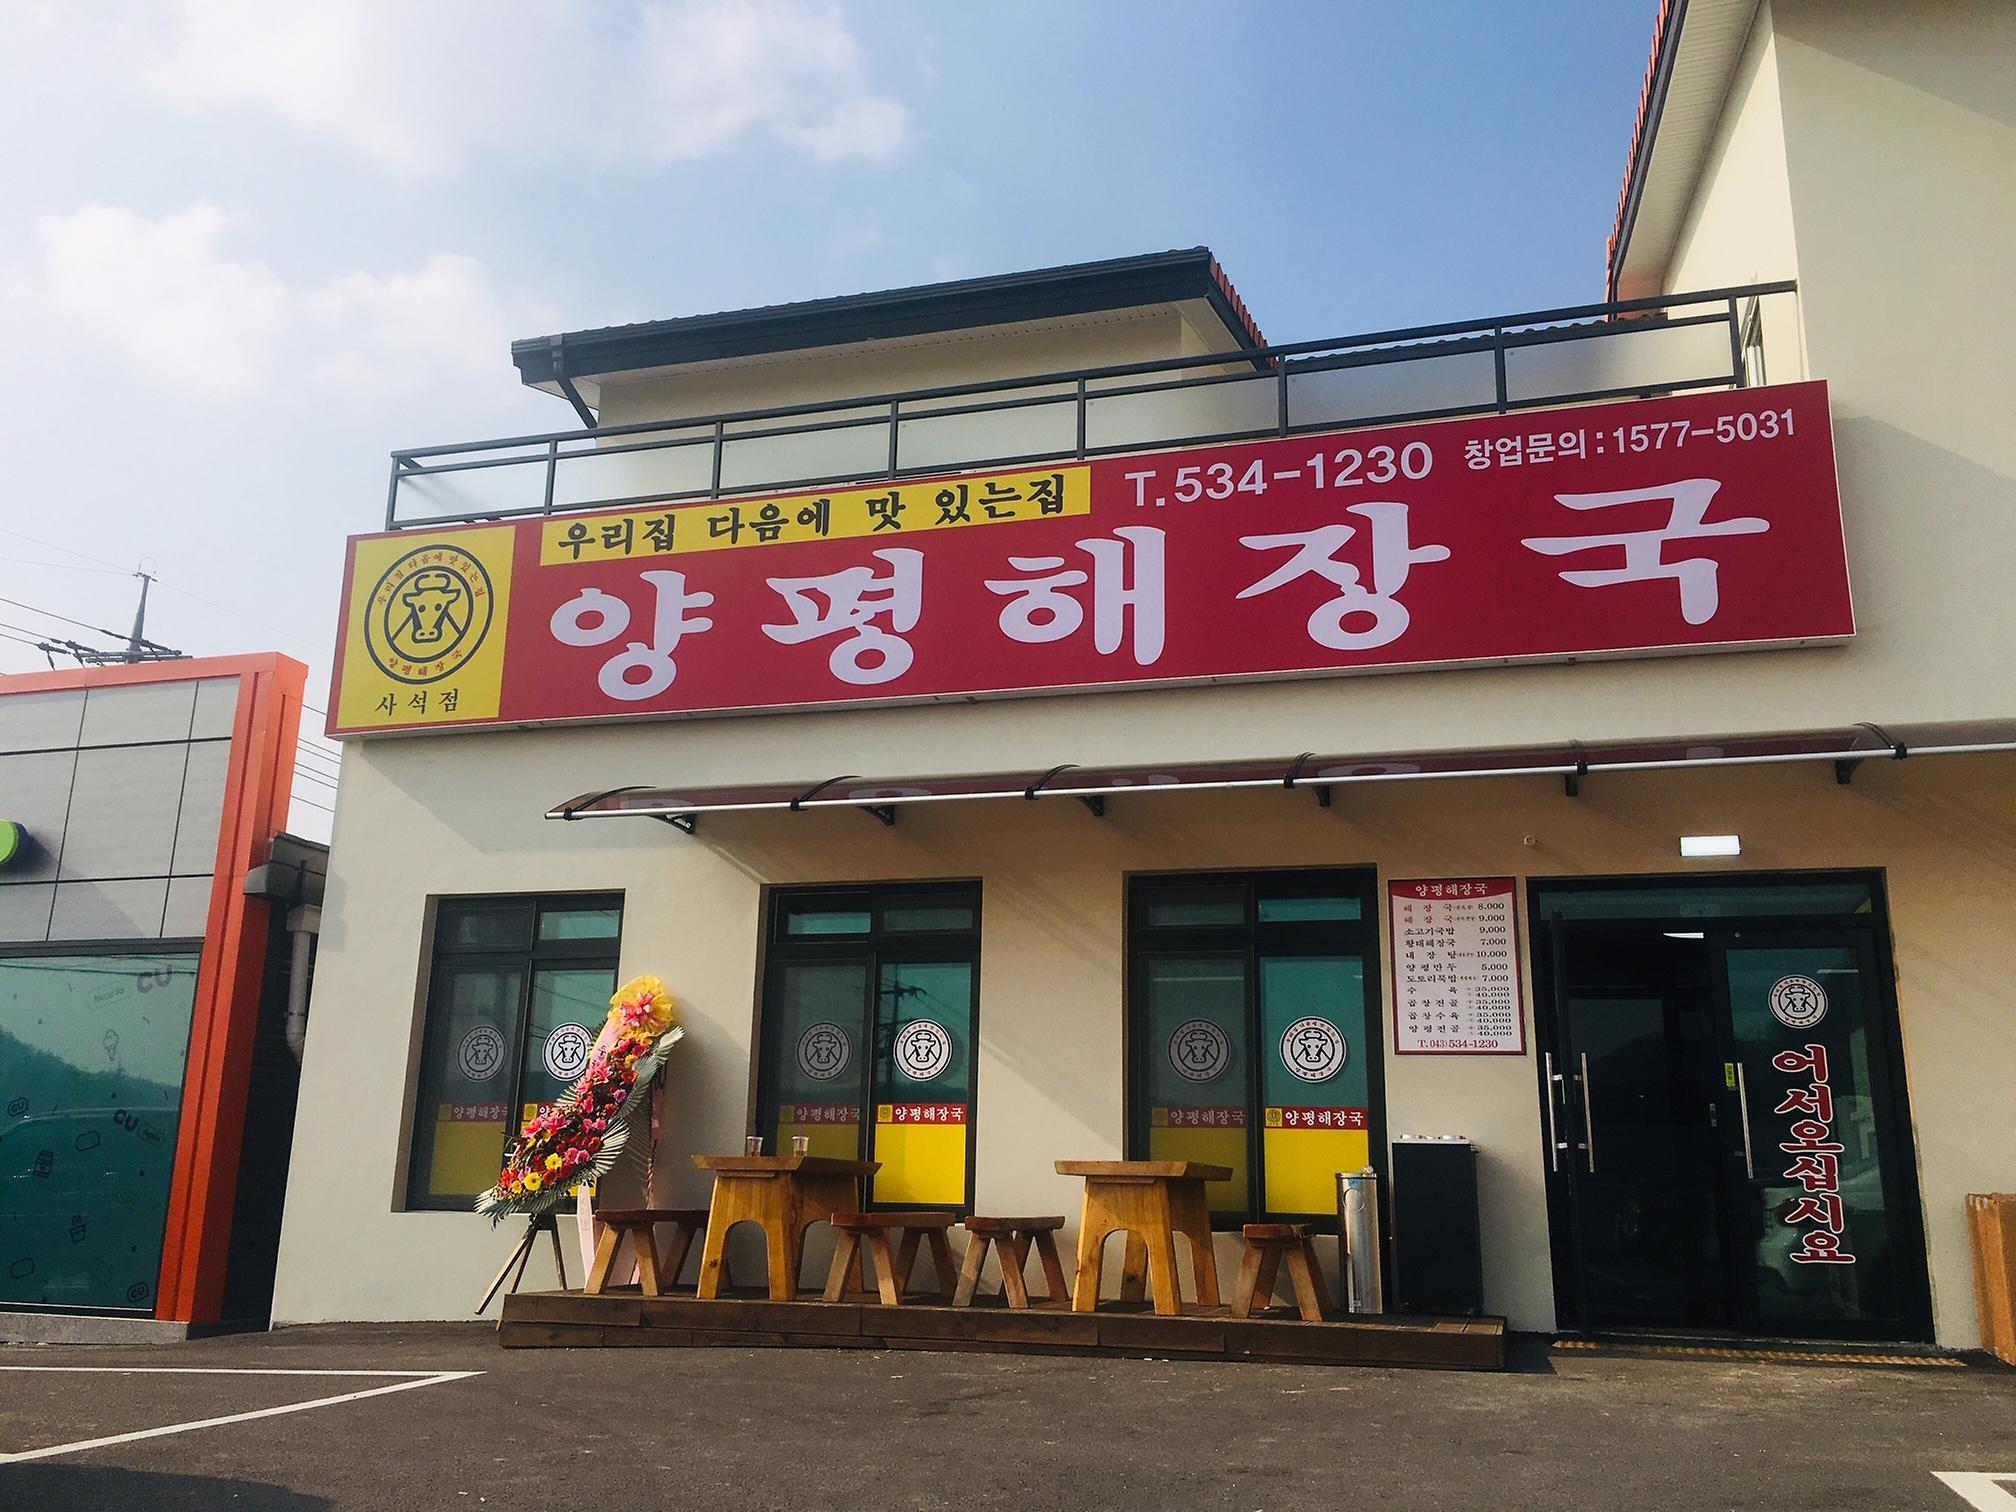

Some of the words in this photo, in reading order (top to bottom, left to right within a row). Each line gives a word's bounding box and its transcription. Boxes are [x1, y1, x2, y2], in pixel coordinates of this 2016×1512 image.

[558, 513, 677, 560] 우리집
[706, 500, 831, 545] 다음에
[550, 477, 1770, 700] 양평해장국
[375, 687, 460, 717] 사석점
[1415, 882, 1488, 897] 양평해장국
[1404, 926, 1455, 936] 소고기국밥
[137, 964, 173, 994] CU
[895, 1106, 964, 1122] 양평해장국
[1171, 1109, 1246, 1125] 양평해장국
[1284, 1109, 1364, 1127] 양평해장국
